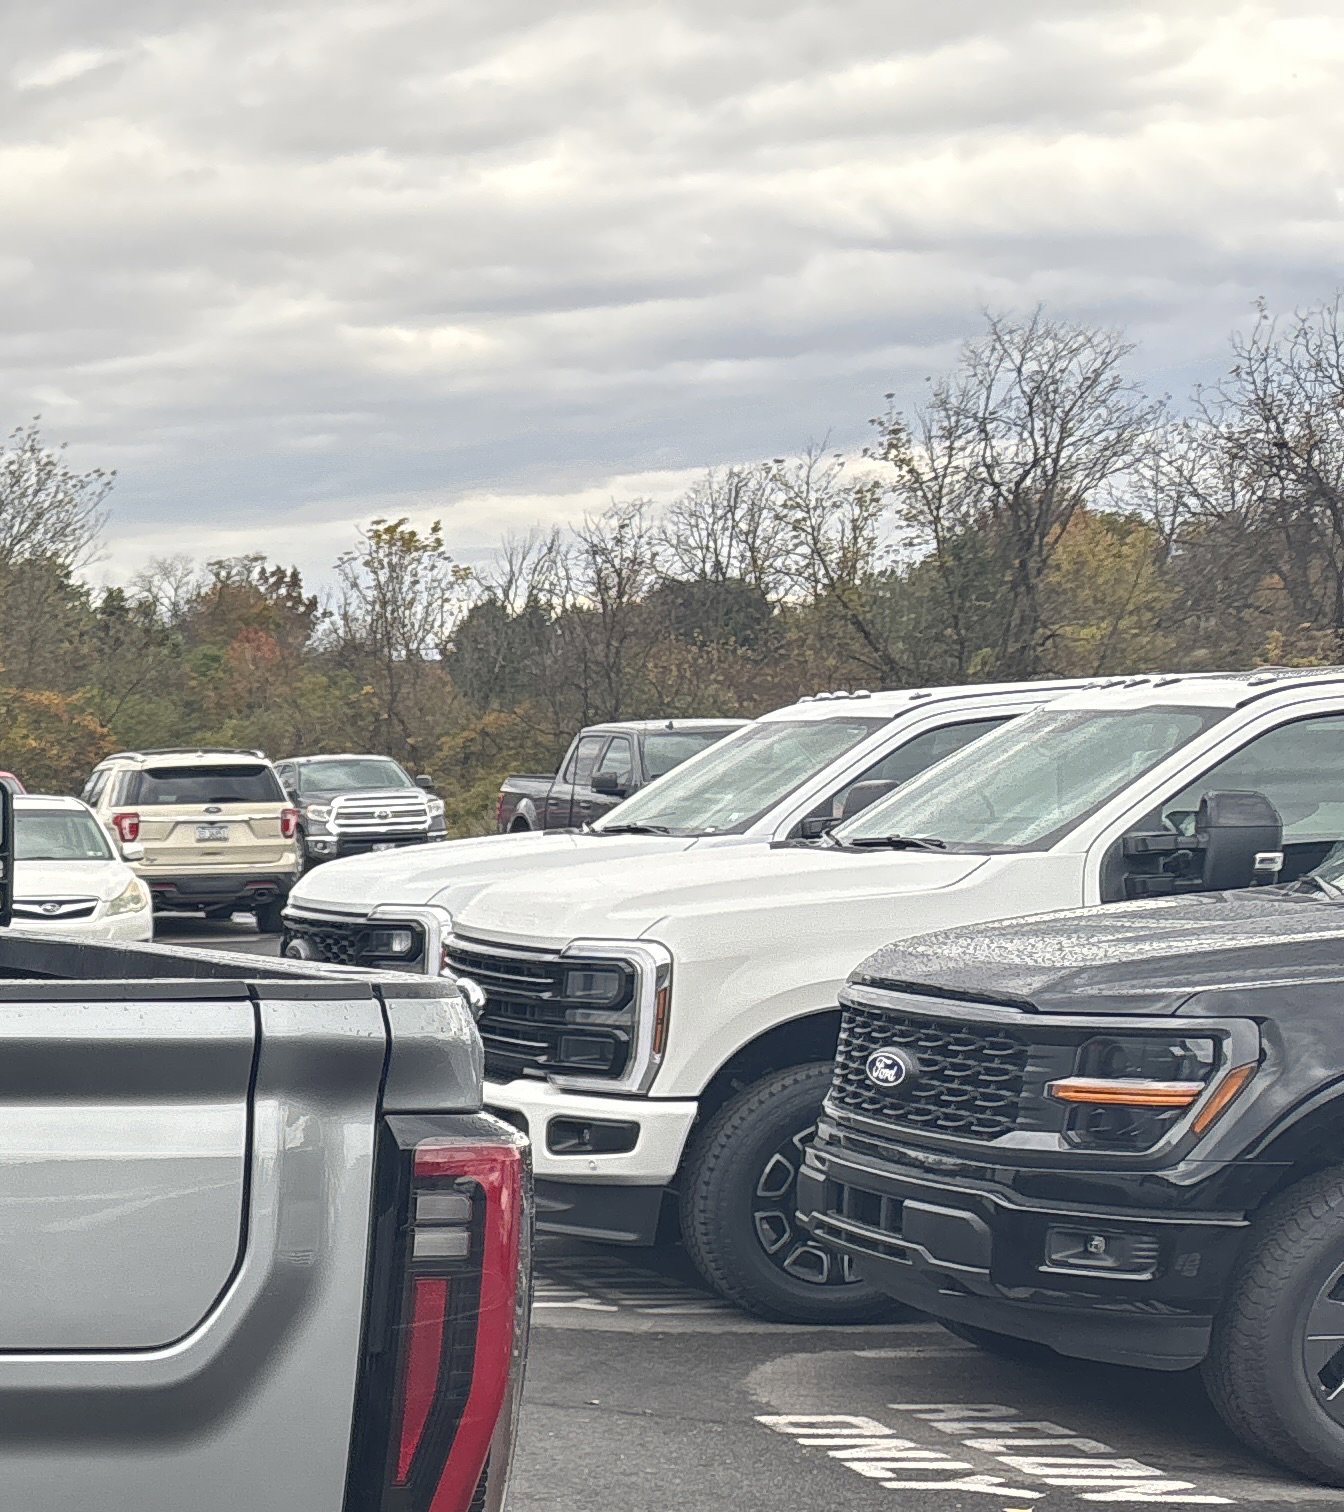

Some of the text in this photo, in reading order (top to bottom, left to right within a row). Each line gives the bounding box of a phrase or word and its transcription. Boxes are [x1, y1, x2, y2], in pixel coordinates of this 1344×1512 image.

[872, 1056, 898, 1082] Ford
[753, 1414, 1048, 1499] ONLY
[888, 1402, 1239, 1504] RECON
